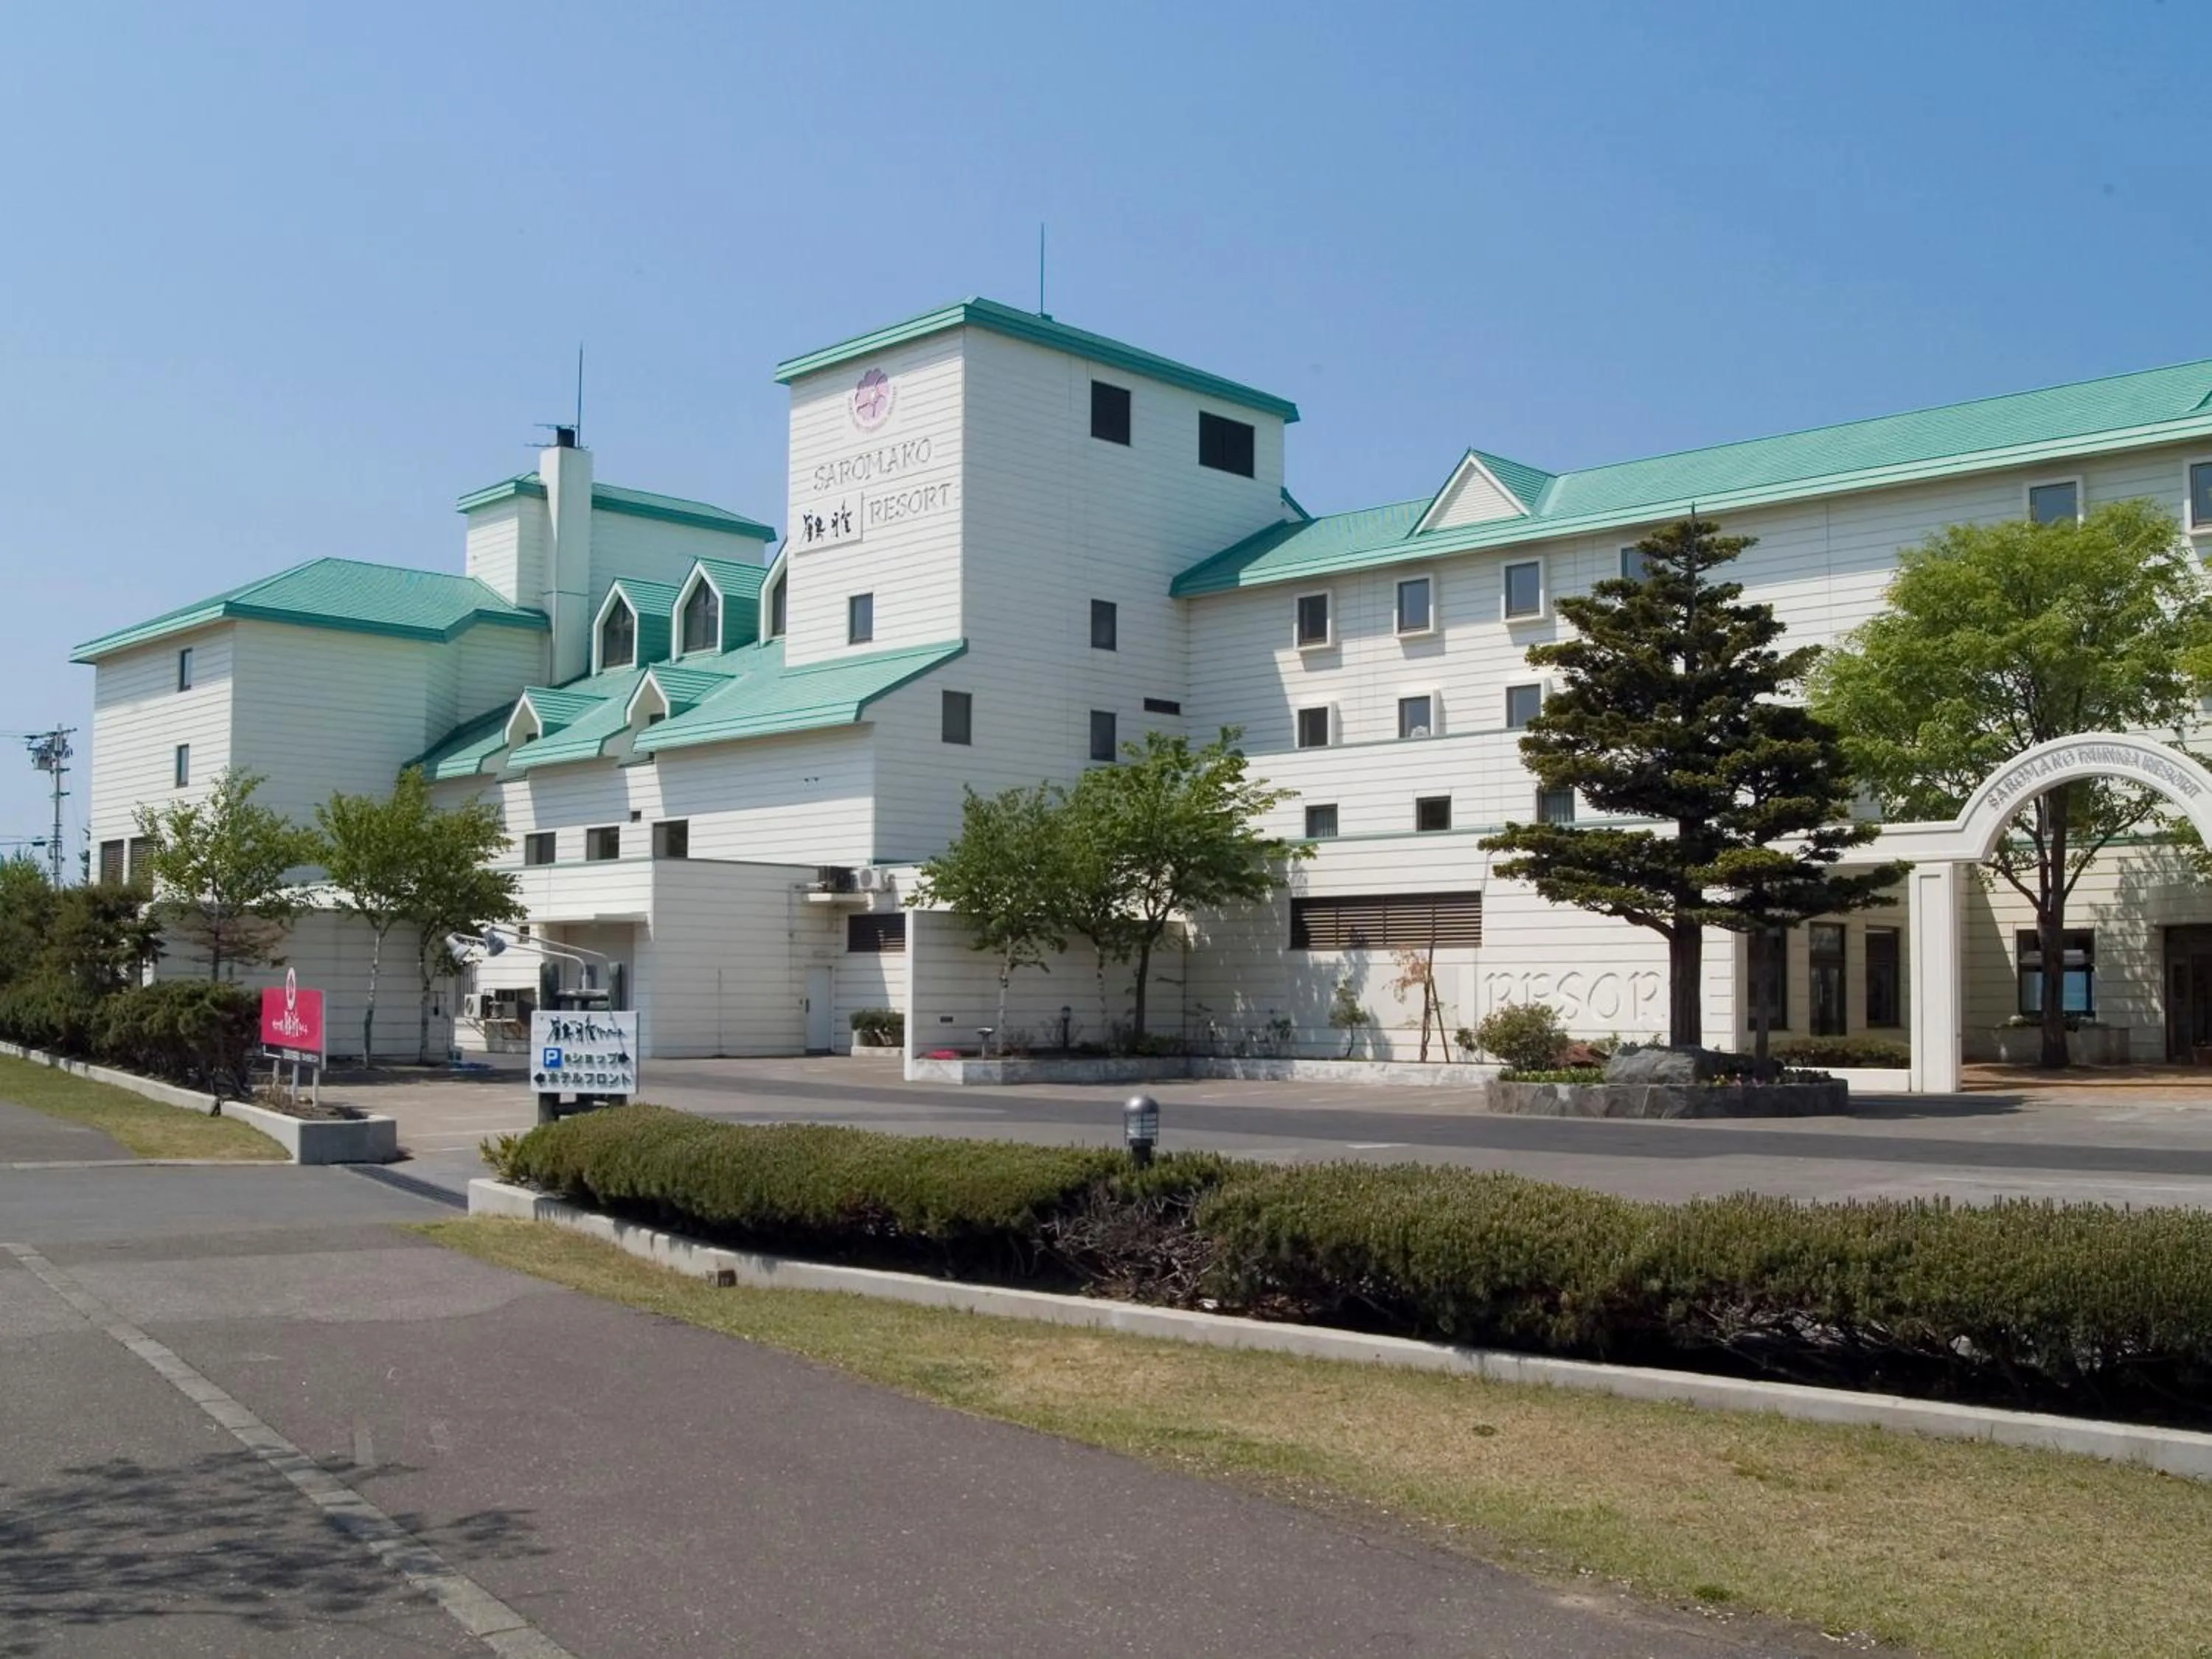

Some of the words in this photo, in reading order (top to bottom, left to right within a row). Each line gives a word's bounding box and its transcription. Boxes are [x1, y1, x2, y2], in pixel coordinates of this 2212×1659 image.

[813, 438, 931, 491] SAROMAKO
[869, 483, 951, 525] RESORT
[1485, 971, 1666, 1023] RESOR
[546, 1050, 558, 1065] P
